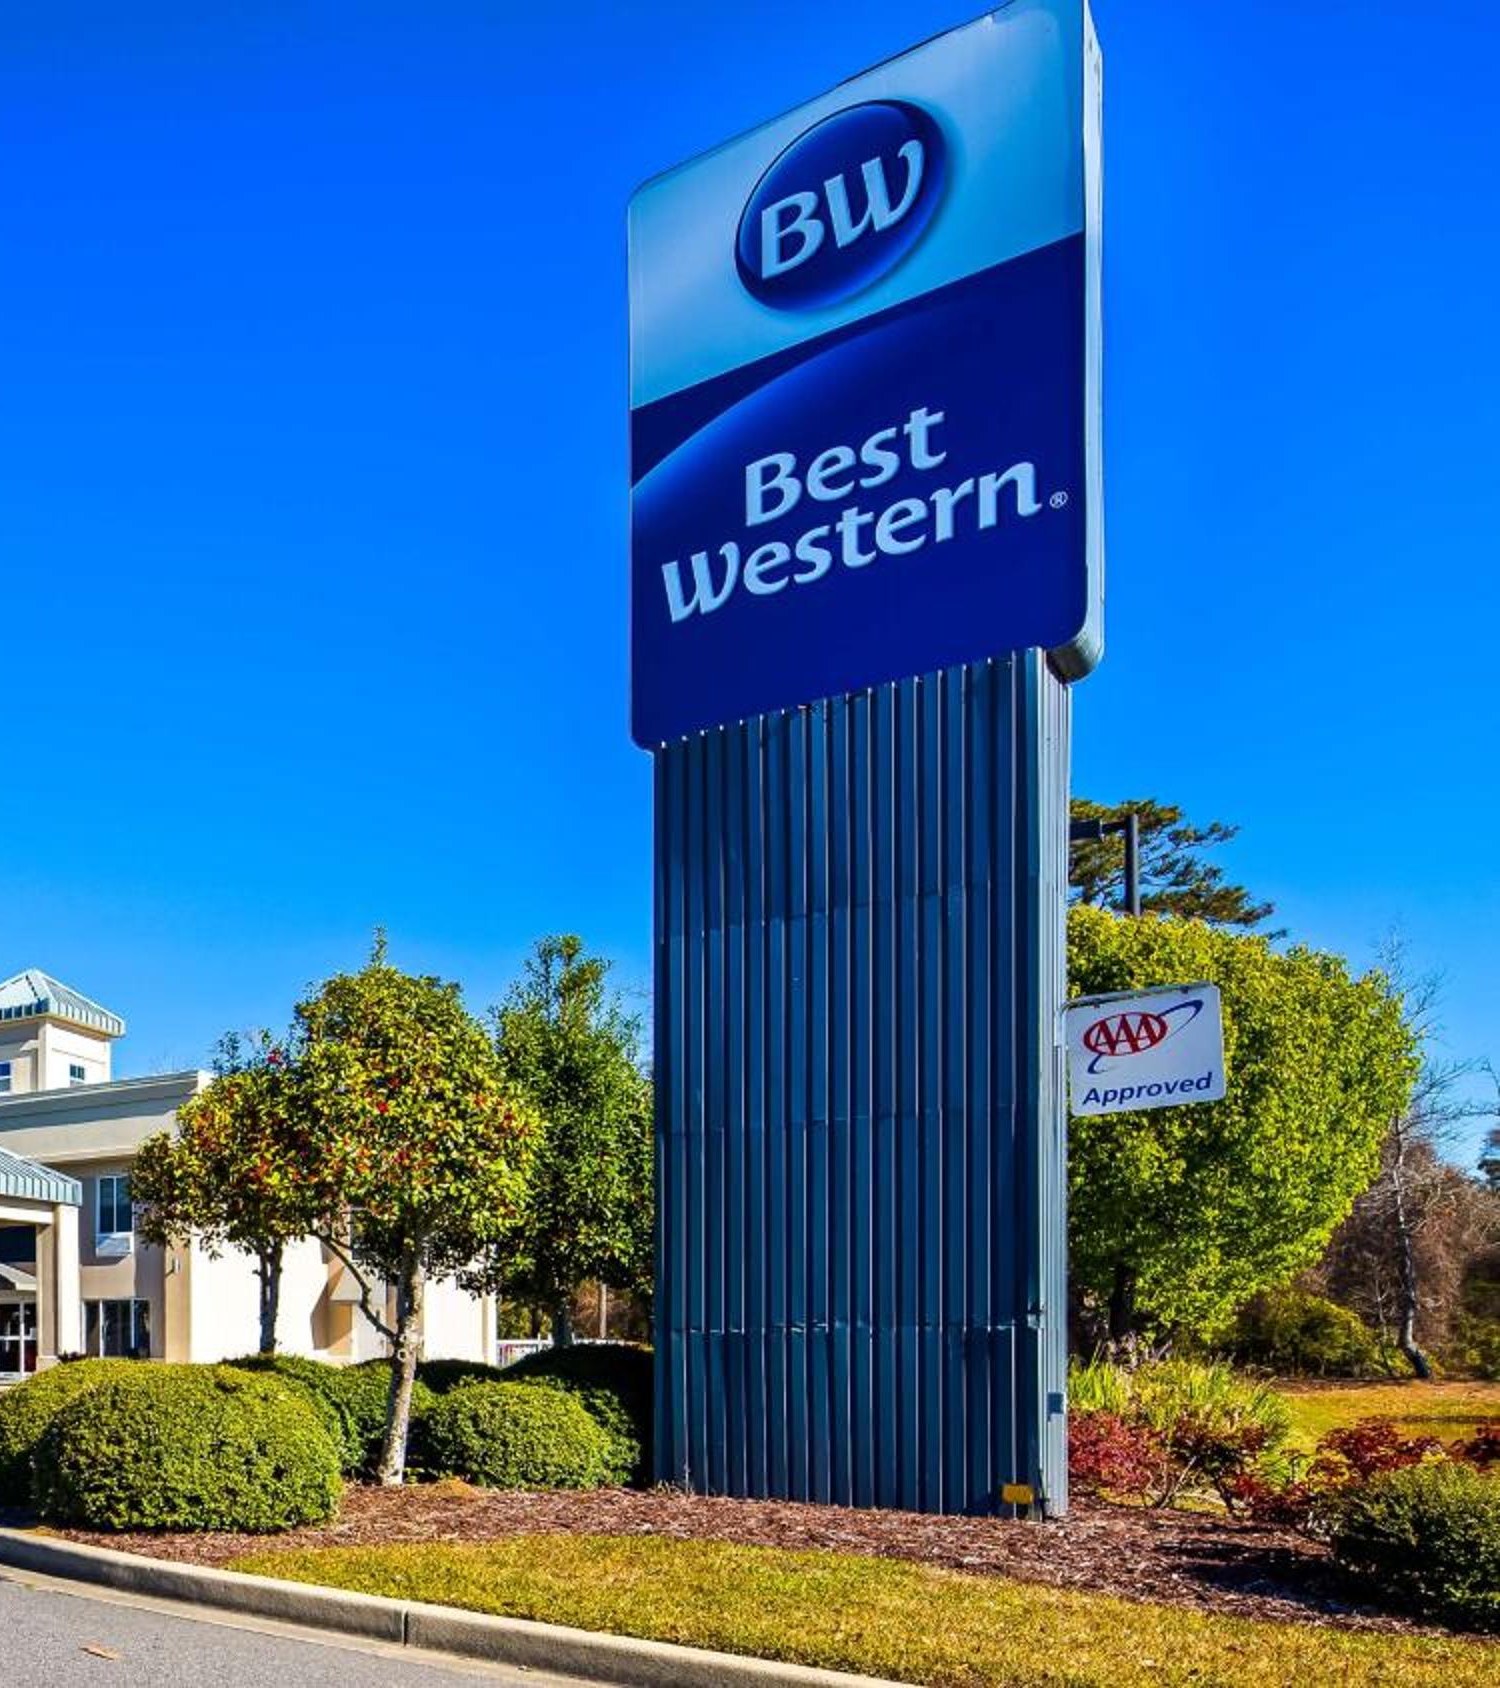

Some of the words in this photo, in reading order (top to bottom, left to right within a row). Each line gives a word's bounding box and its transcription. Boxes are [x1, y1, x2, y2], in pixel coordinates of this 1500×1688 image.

[761, 139, 924, 279] BW
[745, 407, 947, 527] Best
[1092, 1012, 1163, 1056] AAA
[1082, 1071, 1213, 1106] Approved
